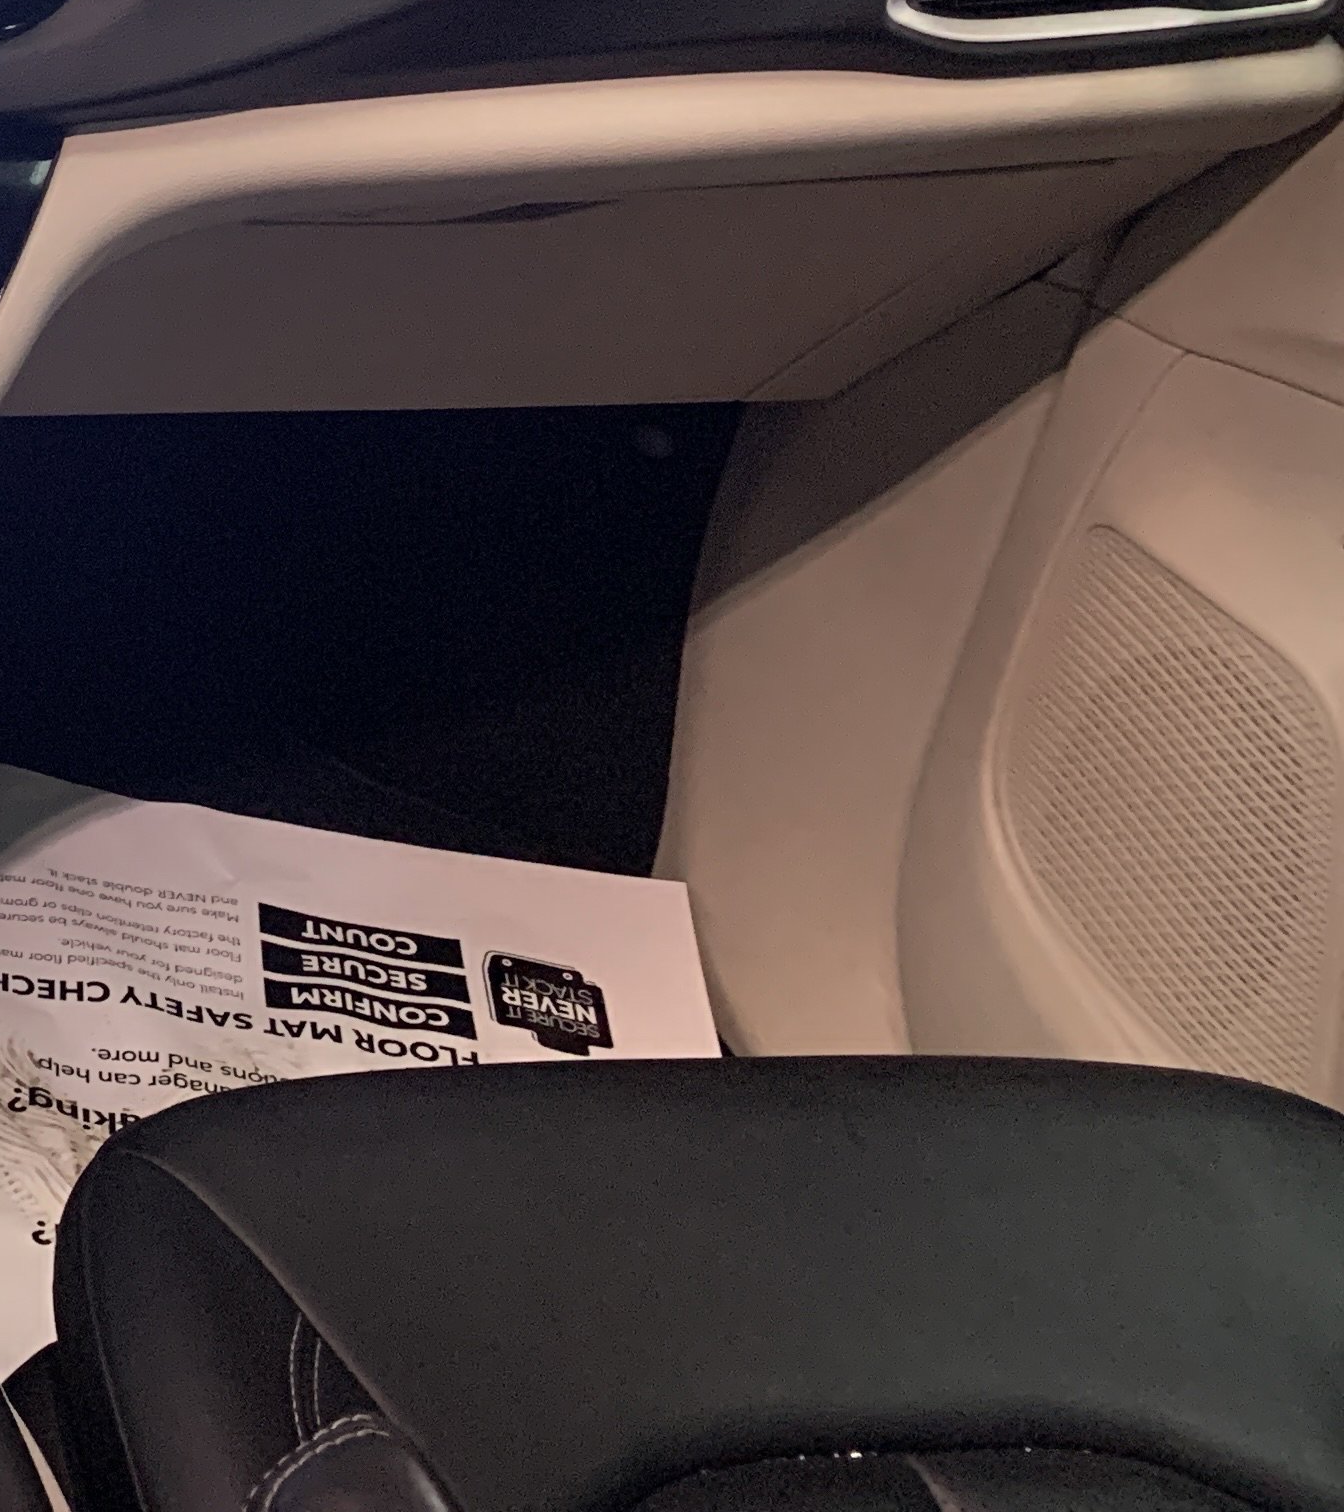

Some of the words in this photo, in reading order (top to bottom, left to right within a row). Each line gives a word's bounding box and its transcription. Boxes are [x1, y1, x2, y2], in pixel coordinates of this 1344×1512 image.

[0, 872, 26, 882] mat
[62, 872, 98, 885] stack
[30, 878, 63, 892] floor
[68, 886, 94, 897] one
[102, 881, 153, 896] double
[99, 893, 131, 908] have
[158, 890, 206, 903] NEVER
[211, 895, 238, 905] and
[136, 901, 162, 911] you
[166, 904, 197, 914] sure
[48, 916, 67, 926] be
[96, 913, 159, 933] retention
[201, 908, 239, 923] Make
[71, 919, 117, 935] always
[163, 925, 213, 942] factory
[121, 932, 168, 950] should
[217, 934, 240, 946] the
[301, 920, 417, 955] COUNT
[116, 949, 146, 961] your
[174, 944, 200, 953] mat
[206, 948, 241, 962] Floor
[28, 953, 62, 964] floor
[67, 954, 133, 971] specified
[151, 959, 170, 971] for
[137, 968, 160, 981] the
[174, 964, 242, 984] designed
[301, 955, 426, 990] SECURE
[165, 975, 195, 989] only
[501, 973, 519, 988] IT
[199, 984, 244, 1000] Install
[519, 976, 593, 1005] STACK
[120, 986, 252, 1030] SAFETY
[291, 987, 449, 1026] CONFIRM
[501, 987, 596, 1024] NEVER
[506, 1006, 521, 1018] IT
[263, 1018, 341, 1043] MAT
[526, 1008, 600, 1038] SECURE
[89, 1041, 160, 1069] more.
[352, 1029, 478, 1070] FLOOR
[35, 1055, 92, 1083] help
[167, 1052, 213, 1075] and
[96, 1067, 141, 1088] can
